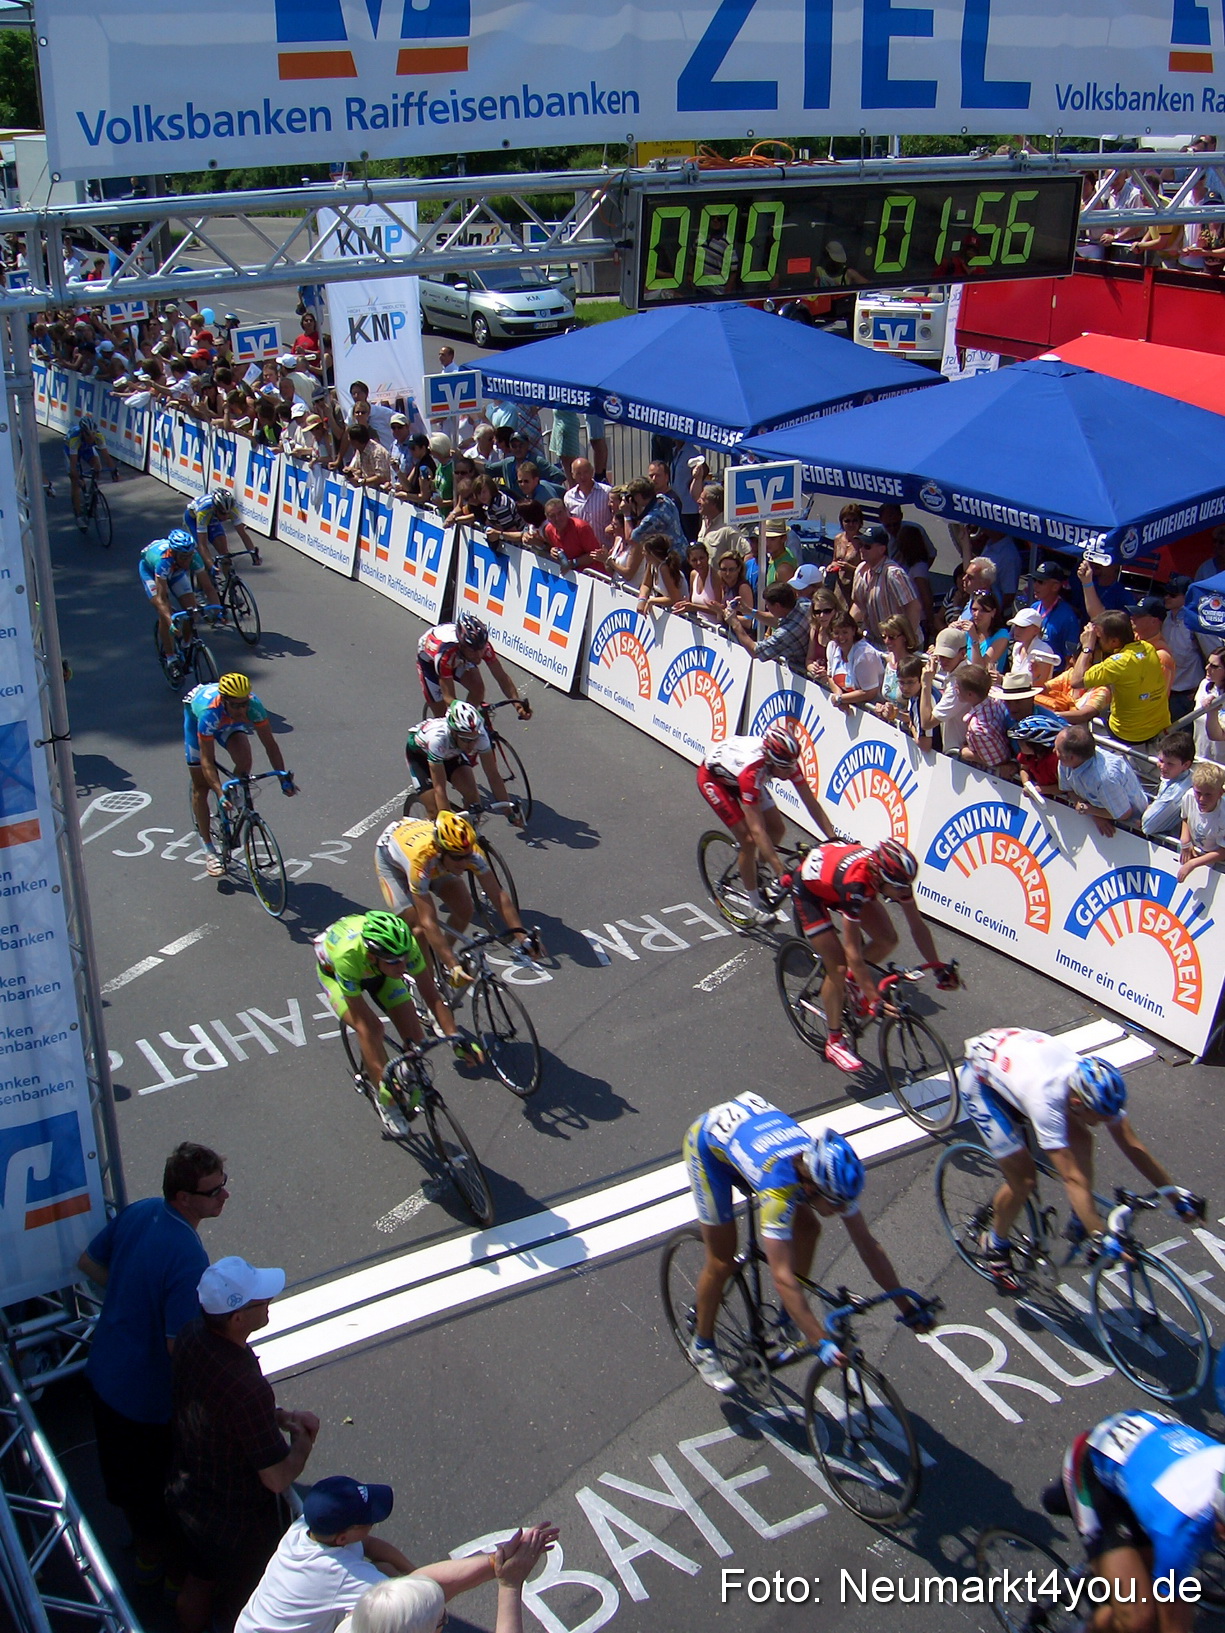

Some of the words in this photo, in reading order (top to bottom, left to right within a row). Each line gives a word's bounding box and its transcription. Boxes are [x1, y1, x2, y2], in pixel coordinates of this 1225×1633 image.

[677, 0, 1032, 112] ZIEL
[76, 99, 333, 147] Volksbanken
[345, 80, 641, 132] Raiffeisenbanken
[1055, 83, 1195, 114] Volksbanken
[335, 224, 403, 257] KMP
[873, 191, 1040, 274] 01:56
[347, 311, 406, 345] KMP
[486, 376, 546, 401] SCHNEIDER
[547, 385, 591, 408] WEISSE
[627, 402, 696, 434] SCHNEIDER
[696, 420, 744, 448] WEISSE
[801, 463, 845, 488] EIDER
[847, 469, 904, 497] WEISSE
[952, 493, 1042, 534] SCHNEIDER
[1045, 517, 1108, 555] WEISSE
[1141, 505, 1199, 545] SCHNEIDER
[1199, 495, 1225, 522] WEIS
[306, 533, 350, 566] Raiffeisenbanken
[355, 558, 388, 585] olksbanken
[387, 574, 437, 613] Raiffeisenbanken
[502, 630, 569, 678] Raiffeisenbanken
[592, 612, 631, 657] GEWINN
[621, 636, 649, 695] SPAREN
[662, 650, 708, 696] GEWINN
[613, 690, 636, 713] Gewinn.
[695, 674, 726, 741] SPAREN
[652, 713, 672, 734] Immer
[672, 726, 682, 740] ein
[682, 732, 707, 756] Gewinn.
[832, 745, 886, 794] GEWINN
[774, 782, 801, 810] Gewinn.
[935, 807, 1012, 860] GEWINN
[994, 838, 1047, 926] SPAREN
[1074, 871, 1161, 927] GEWINN
[916, 881, 952, 909] Immer
[954, 900, 972, 918] ein
[974, 911, 1020, 943] Gewinn.
[1141, 907, 1196, 1005] SPAREN
[1055, 948, 1094, 979] Immer
[1096, 971, 1115, 991] ein
[1117, 981, 1166, 1019] Gewinn.
